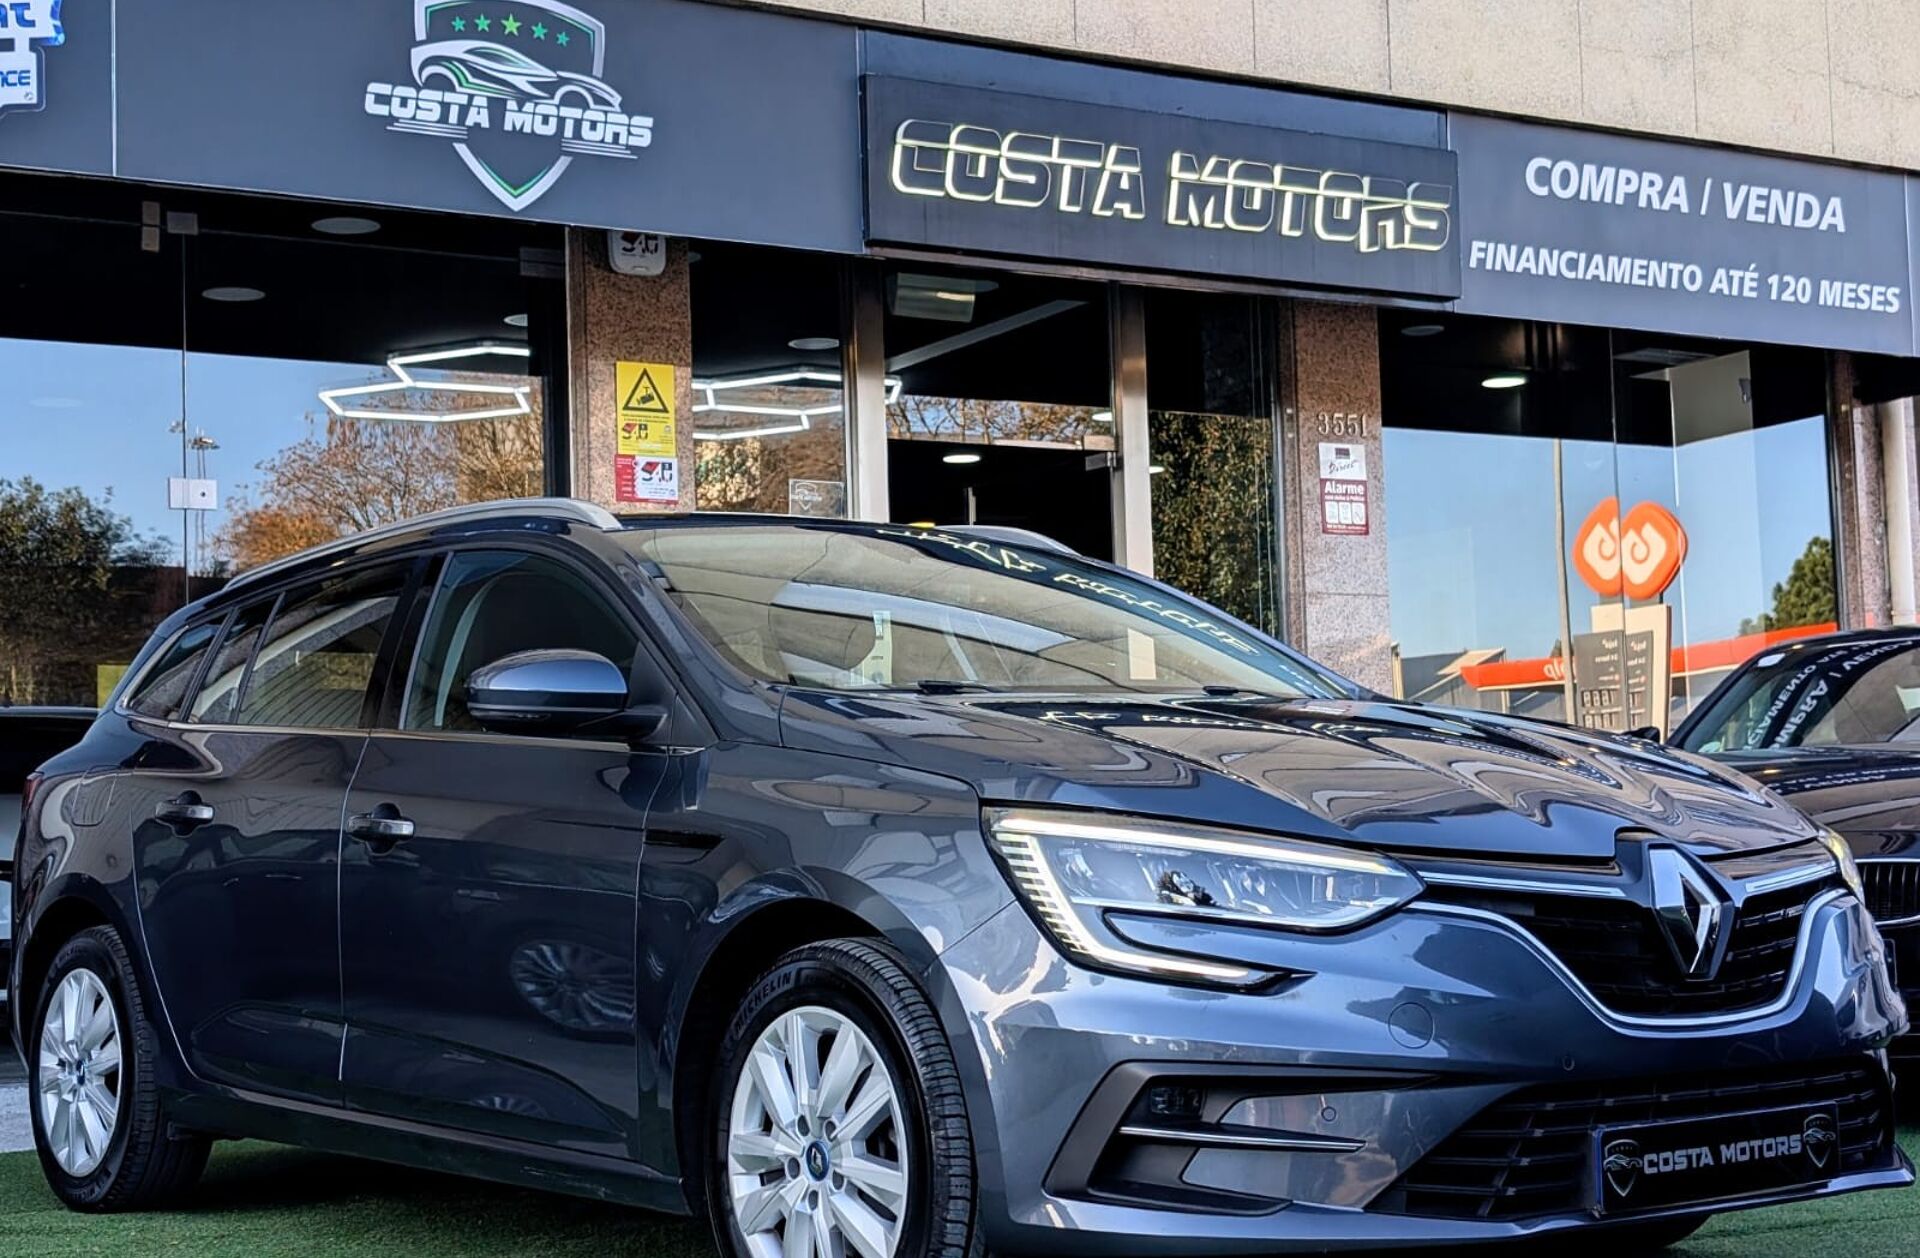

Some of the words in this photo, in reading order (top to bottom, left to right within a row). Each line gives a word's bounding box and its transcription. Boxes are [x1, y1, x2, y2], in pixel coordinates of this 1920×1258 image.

[365, 82, 489, 128] COSTA
[504, 100, 653, 148] MOTORS
[893, 118, 1145, 220] COSTA
[1167, 151, 1453, 253] MOTORS
[1525, 157, 1689, 213] COMPRA
[1700, 178, 1712, 215] /
[1723, 182, 1846, 232] VENDA
[1469, 241, 1702, 292] FINANCIAMENTO
[1710, 264, 1758, 298] ATÉ
[1767, 274, 1811, 304] 120
[1819, 279, 1900, 314] MESES
[1318, 411, 1367, 437] 3551
[1325, 481, 1365, 495] Alarme
[1643, 1146, 1715, 1175] COSTA
[1719, 1133, 1802, 1164] MOTORS
